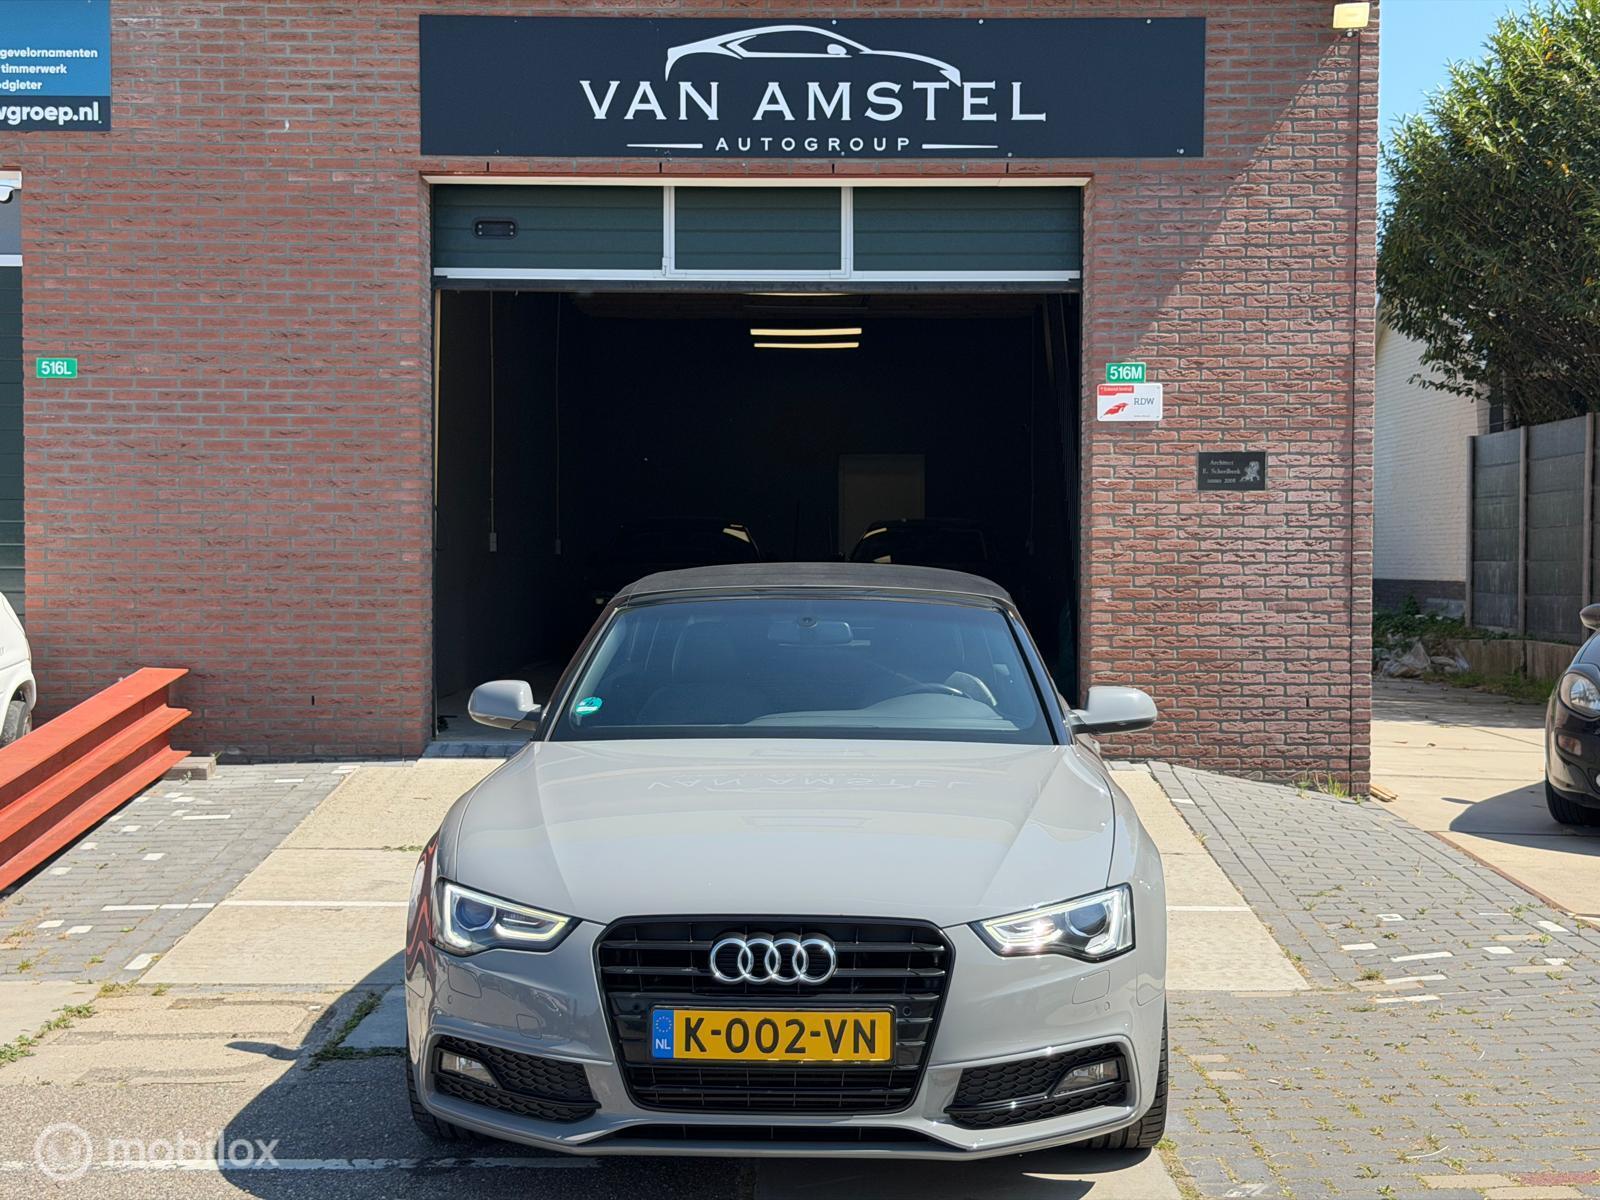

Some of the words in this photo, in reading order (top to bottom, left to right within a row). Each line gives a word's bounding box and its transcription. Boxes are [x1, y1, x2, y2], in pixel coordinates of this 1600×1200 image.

[0, 46, 98, 59] gevelornamenten
[1, 63, 67, 74] timmerwerk
[0, 79, 42, 91] dgieter
[579, 80, 719, 121] VAN
[752, 80, 1047, 121] AMSTEL
[715, 137, 911, 152] AUTOGROUP
[41, 361, 73, 375] 516L
[1110, 366, 1143, 380] 516M
[1133, 397, 1155, 406] RDW
[684, 1017, 876, 1054] K-002-VN
[655, 1038, 671, 1050] NL
